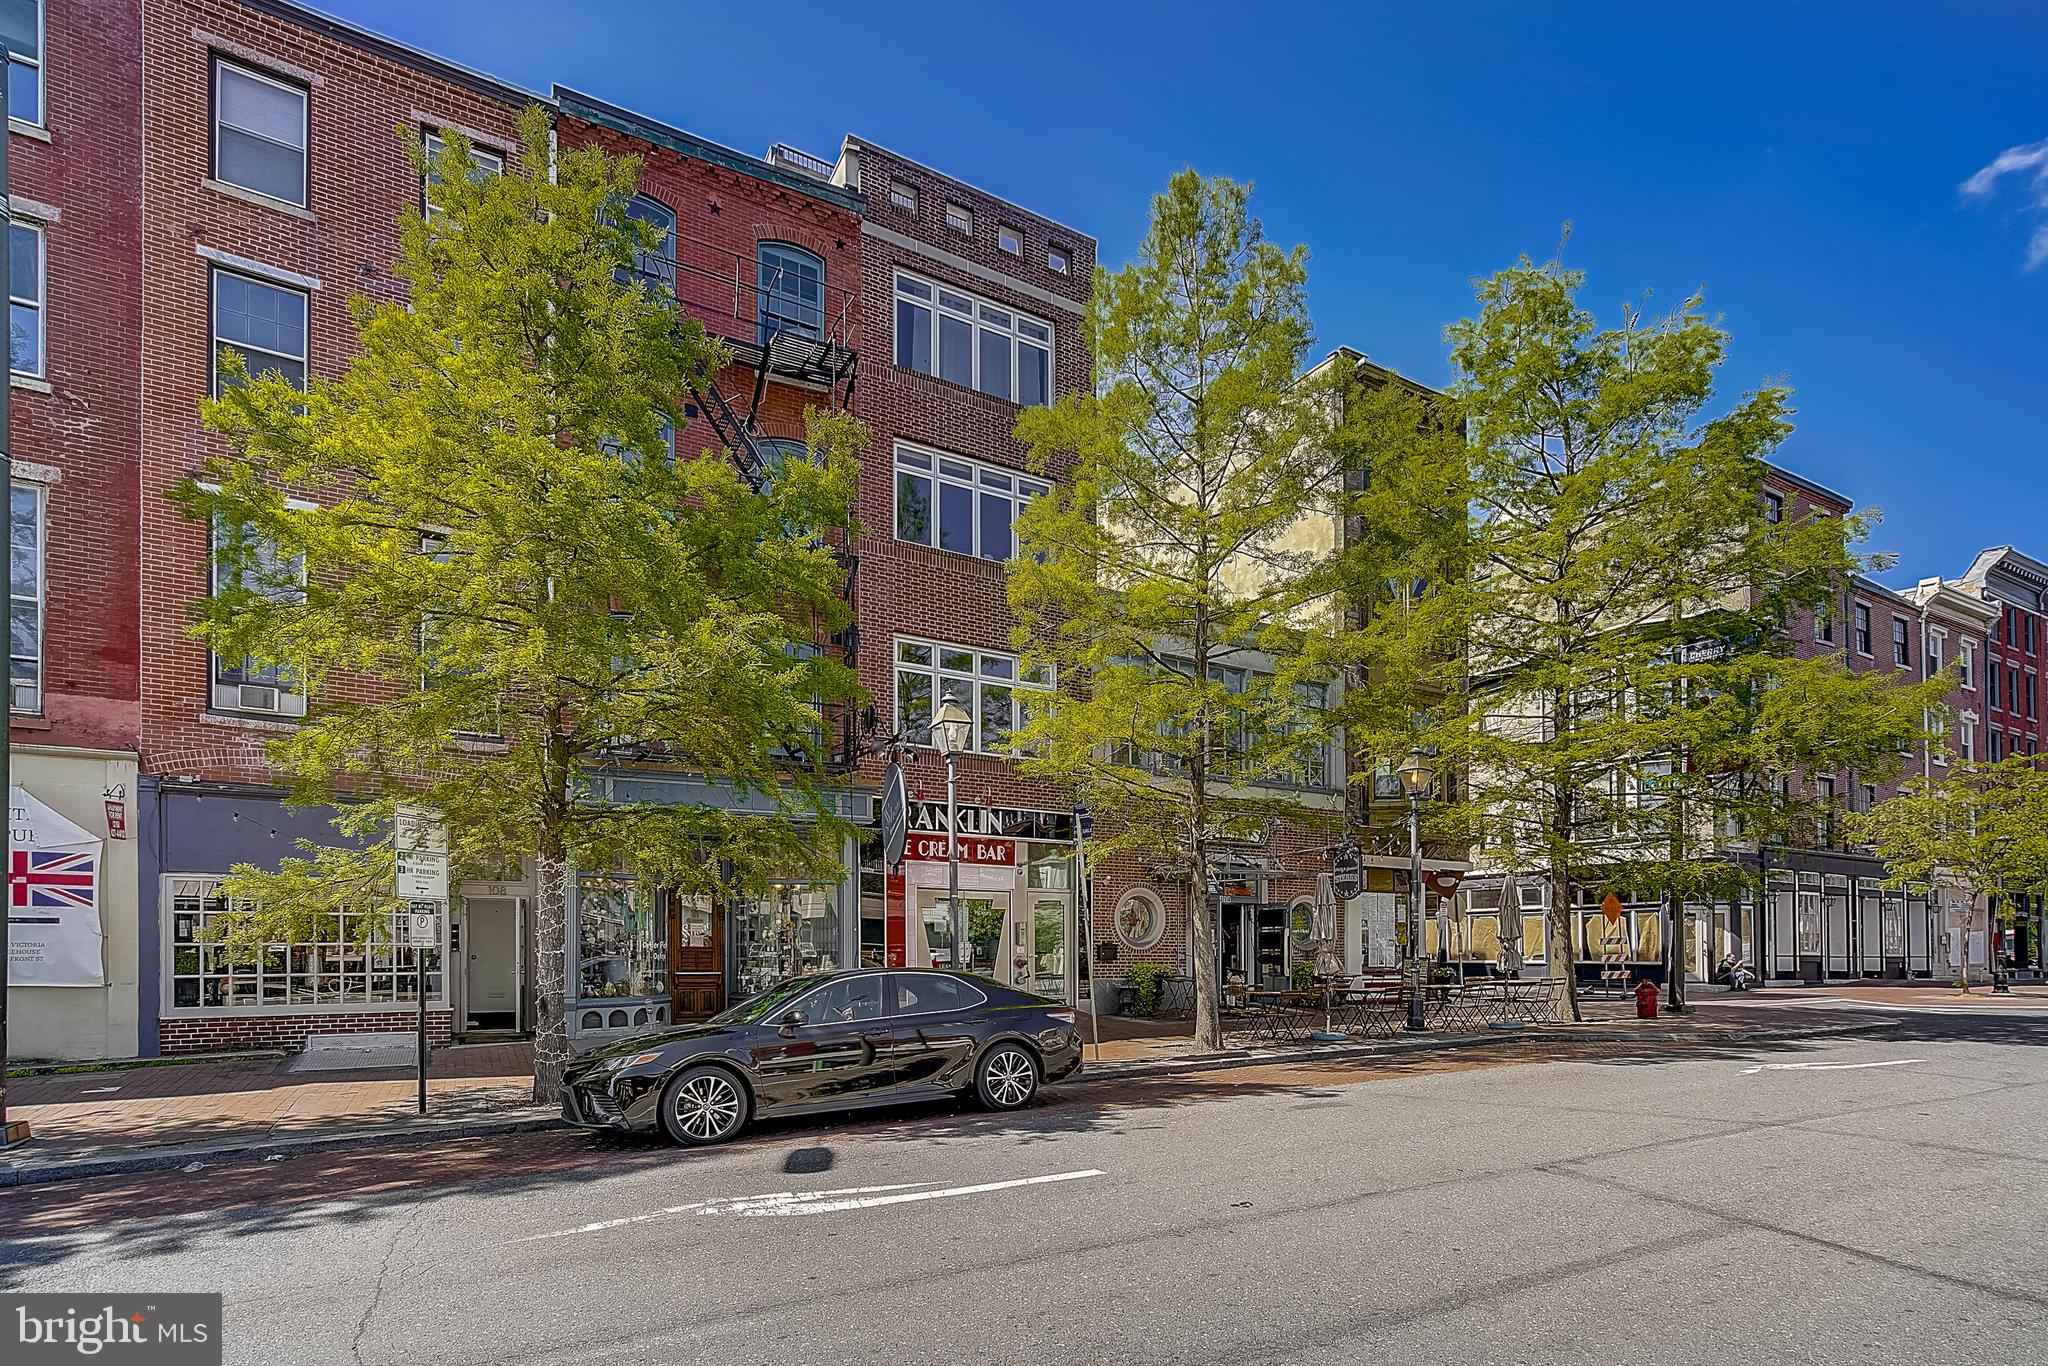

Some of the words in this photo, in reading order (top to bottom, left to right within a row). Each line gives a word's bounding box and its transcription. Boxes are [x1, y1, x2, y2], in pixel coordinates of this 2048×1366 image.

[977, 845, 1006, 861] BAR
[415, 854, 440, 864] PARKING
[415, 868, 440, 877] PARKING
